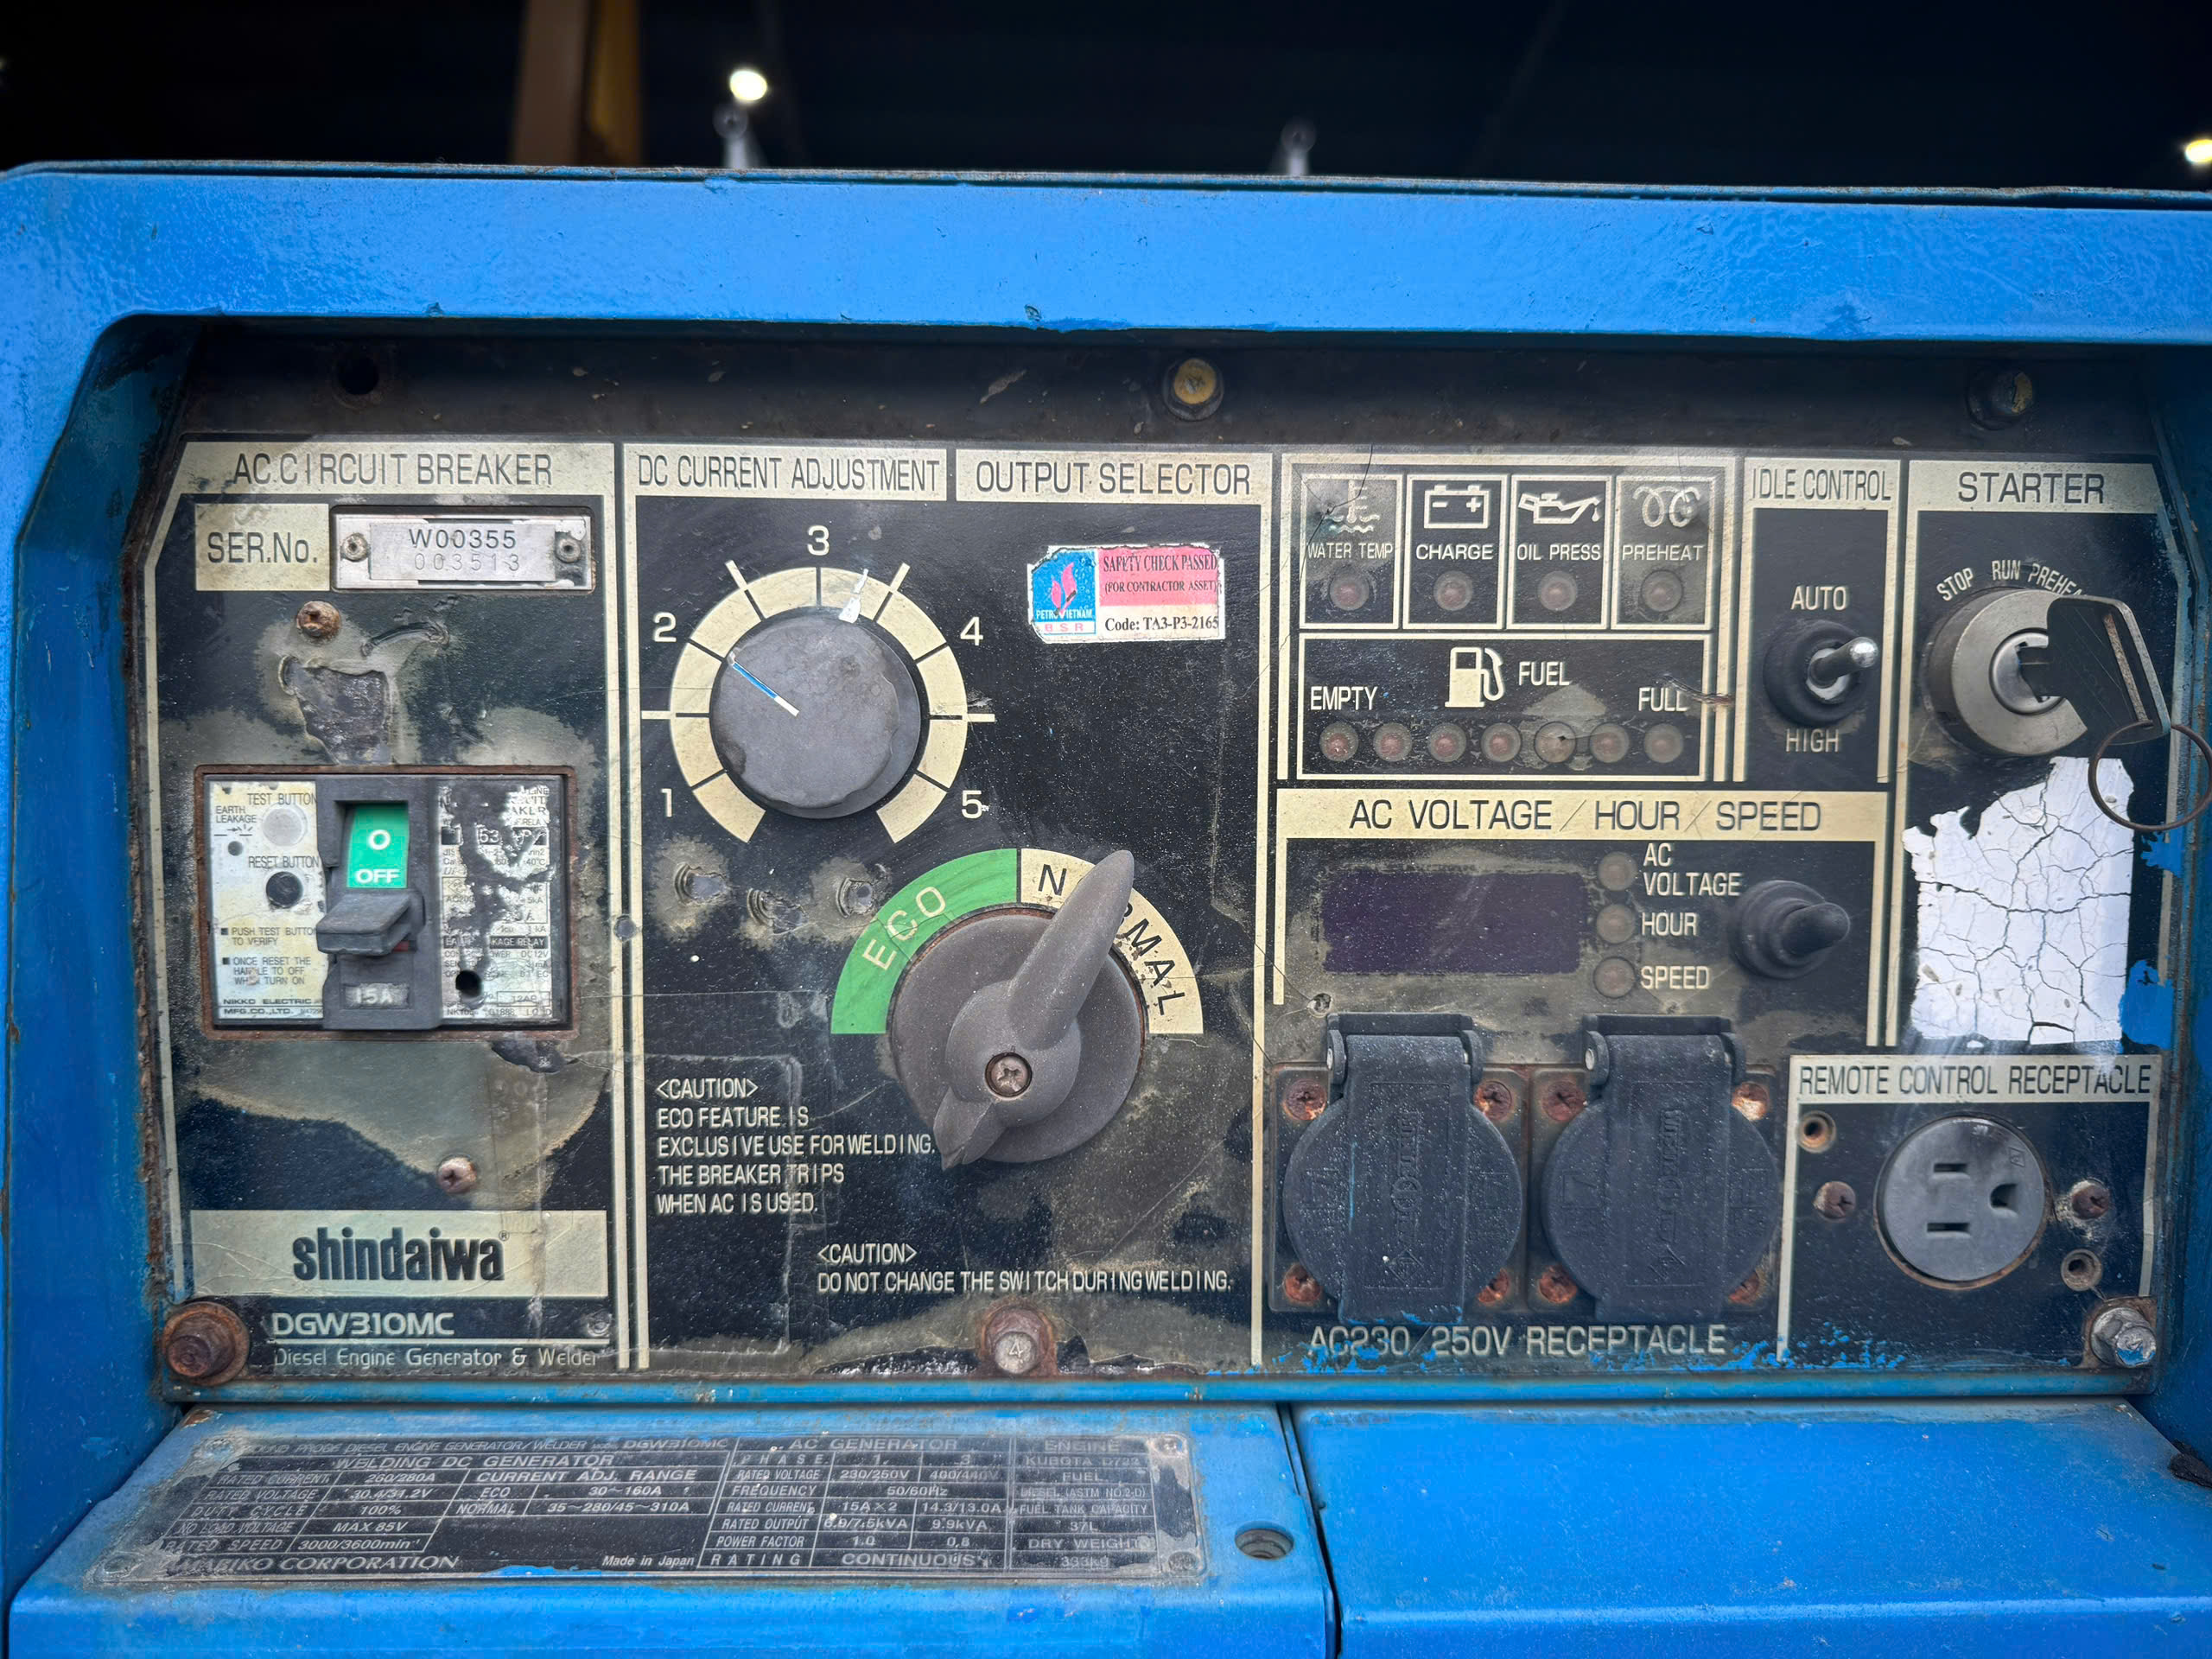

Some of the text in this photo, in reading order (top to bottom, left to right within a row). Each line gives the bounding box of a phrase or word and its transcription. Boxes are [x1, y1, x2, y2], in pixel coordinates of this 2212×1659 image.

[279, 454, 407, 485] CIRCUIT
[417, 454, 552, 486] BREAKER
[638, 455, 940, 491] DC CURRENT ADJUSTMENT
[976, 461, 1250, 495] OUTPUT SELECTOR
[1752, 467, 1891, 501] IDLE CONTROL
[1958, 471, 2104, 505] STARTER
[207, 532, 317, 563] SER.No.
[409, 529, 517, 549] W00355
[807, 525, 830, 556] 3
[1307, 543, 1393, 560] WATER TEMP
[1416, 544, 1493, 561] CHARGE
[1516, 544, 1601, 561] OIL PRESS
[1622, 545, 1704, 562] PREHEAT
[414, 553, 520, 573] 003513
[1103, 554, 1217, 572] SAFETY CHECK PASSED
[1992, 560, 2021, 581] RUN
[1127, 581, 1185, 593] CONTRACTOR
[1936, 567, 1974, 601] STOP
[1791, 586, 1847, 611] AUTO
[652, 613, 677, 643] 2
[960, 616, 984, 646] 4
[1105, 616, 1218, 632] Code: TA3-P3-2165
[1518, 662, 1571, 686] FUEL
[1310, 687, 1377, 711] EMPTY
[1638, 688, 1688, 712] FULL
[1785, 729, 1840, 753] HIGH
[247, 792, 317, 806] TEST BUTTON
[660, 789, 673, 817] 1
[961, 790, 984, 819] 5
[1349, 798, 1821, 831] AC VOLTAGE HOUR SPEED
[248, 856, 320, 868] RESET BUTTON
[1643, 842, 1672, 867] AC
[355, 868, 402, 884] OFF
[1644, 872, 1740, 896] VOLTAGE
[232, 927, 281, 936] PUSH TEST
[1643, 912, 1697, 936] HOUR
[248, 938, 278, 946] VERIFY
[296, 957, 311, 965] THE
[265, 976, 288, 985] TURN
[1641, 966, 1710, 989] SPEED
[1800, 1065, 2152, 1095] REMOTE CONTROL RECEPTACLE
[658, 1106, 810, 1129] ECO FEATURE IS
[658, 1133, 936, 1159] EXCLUSIVE USE FOR WELDING.
[658, 1163, 845, 1186] THE BREAKER TRIPS
[657, 1192, 818, 1215] WHEN AC IS USED.
[292, 1226, 505, 1281] shindaiwa
[818, 1270, 1231, 1293] DO NOT CHANGE THE SWITCH DURING WELDING.
[272, 1313, 454, 1336] DGW310MC
[1526, 1324, 1726, 1357] RECEPTACLE
[275, 1346, 598, 1370] Diesel Engine Generator & Welder
[788, 1438, 957, 1450] AC GENERATOR
[336, 1454, 614, 1469] WELDING DC GENERATOR
[1026, 1457, 1092, 1466] KUBOTA
[217, 1472, 435, 1484] RATED CURRENT 260/280A
[477, 1470, 697, 1483] CURRENT ADJ. RANGE
[737, 1469, 911, 1480] RATED VOLTAGE 230/250V
[1063, 1471, 1103, 1481] FUEL
[205, 1489, 319, 1501] RATED VOLTAGE
[480, 1487, 511, 1498] ECO
[732, 1484, 948, 1497] FREQUENCY 50/60Hz
[250, 1505, 308, 1517] CYCLE
[360, 1505, 402, 1516] 100%
[455, 1503, 516, 1515] NORMAL
[727, 1501, 1002, 1513] RATED CURRENT 14.3/13.0A
[1020, 1504, 1147, 1514] FUEL TANK CAPACITY
[333, 1522, 409, 1532] MAX 85V
[721, 1518, 988, 1530] RATED OUTPUT 9.9kVA
[1070, 1521, 1098, 1532] 37L
[228, 1539, 283, 1551] SPEED
[715, 1535, 804, 1547] POWER FACTOR
[1028, 1538, 1065, 1548] DRY
[280, 1555, 460, 1570] CORPORATION
[602, 1555, 695, 1568] Made in Japan
[842, 1553, 976, 1567] CONTINUOUS
